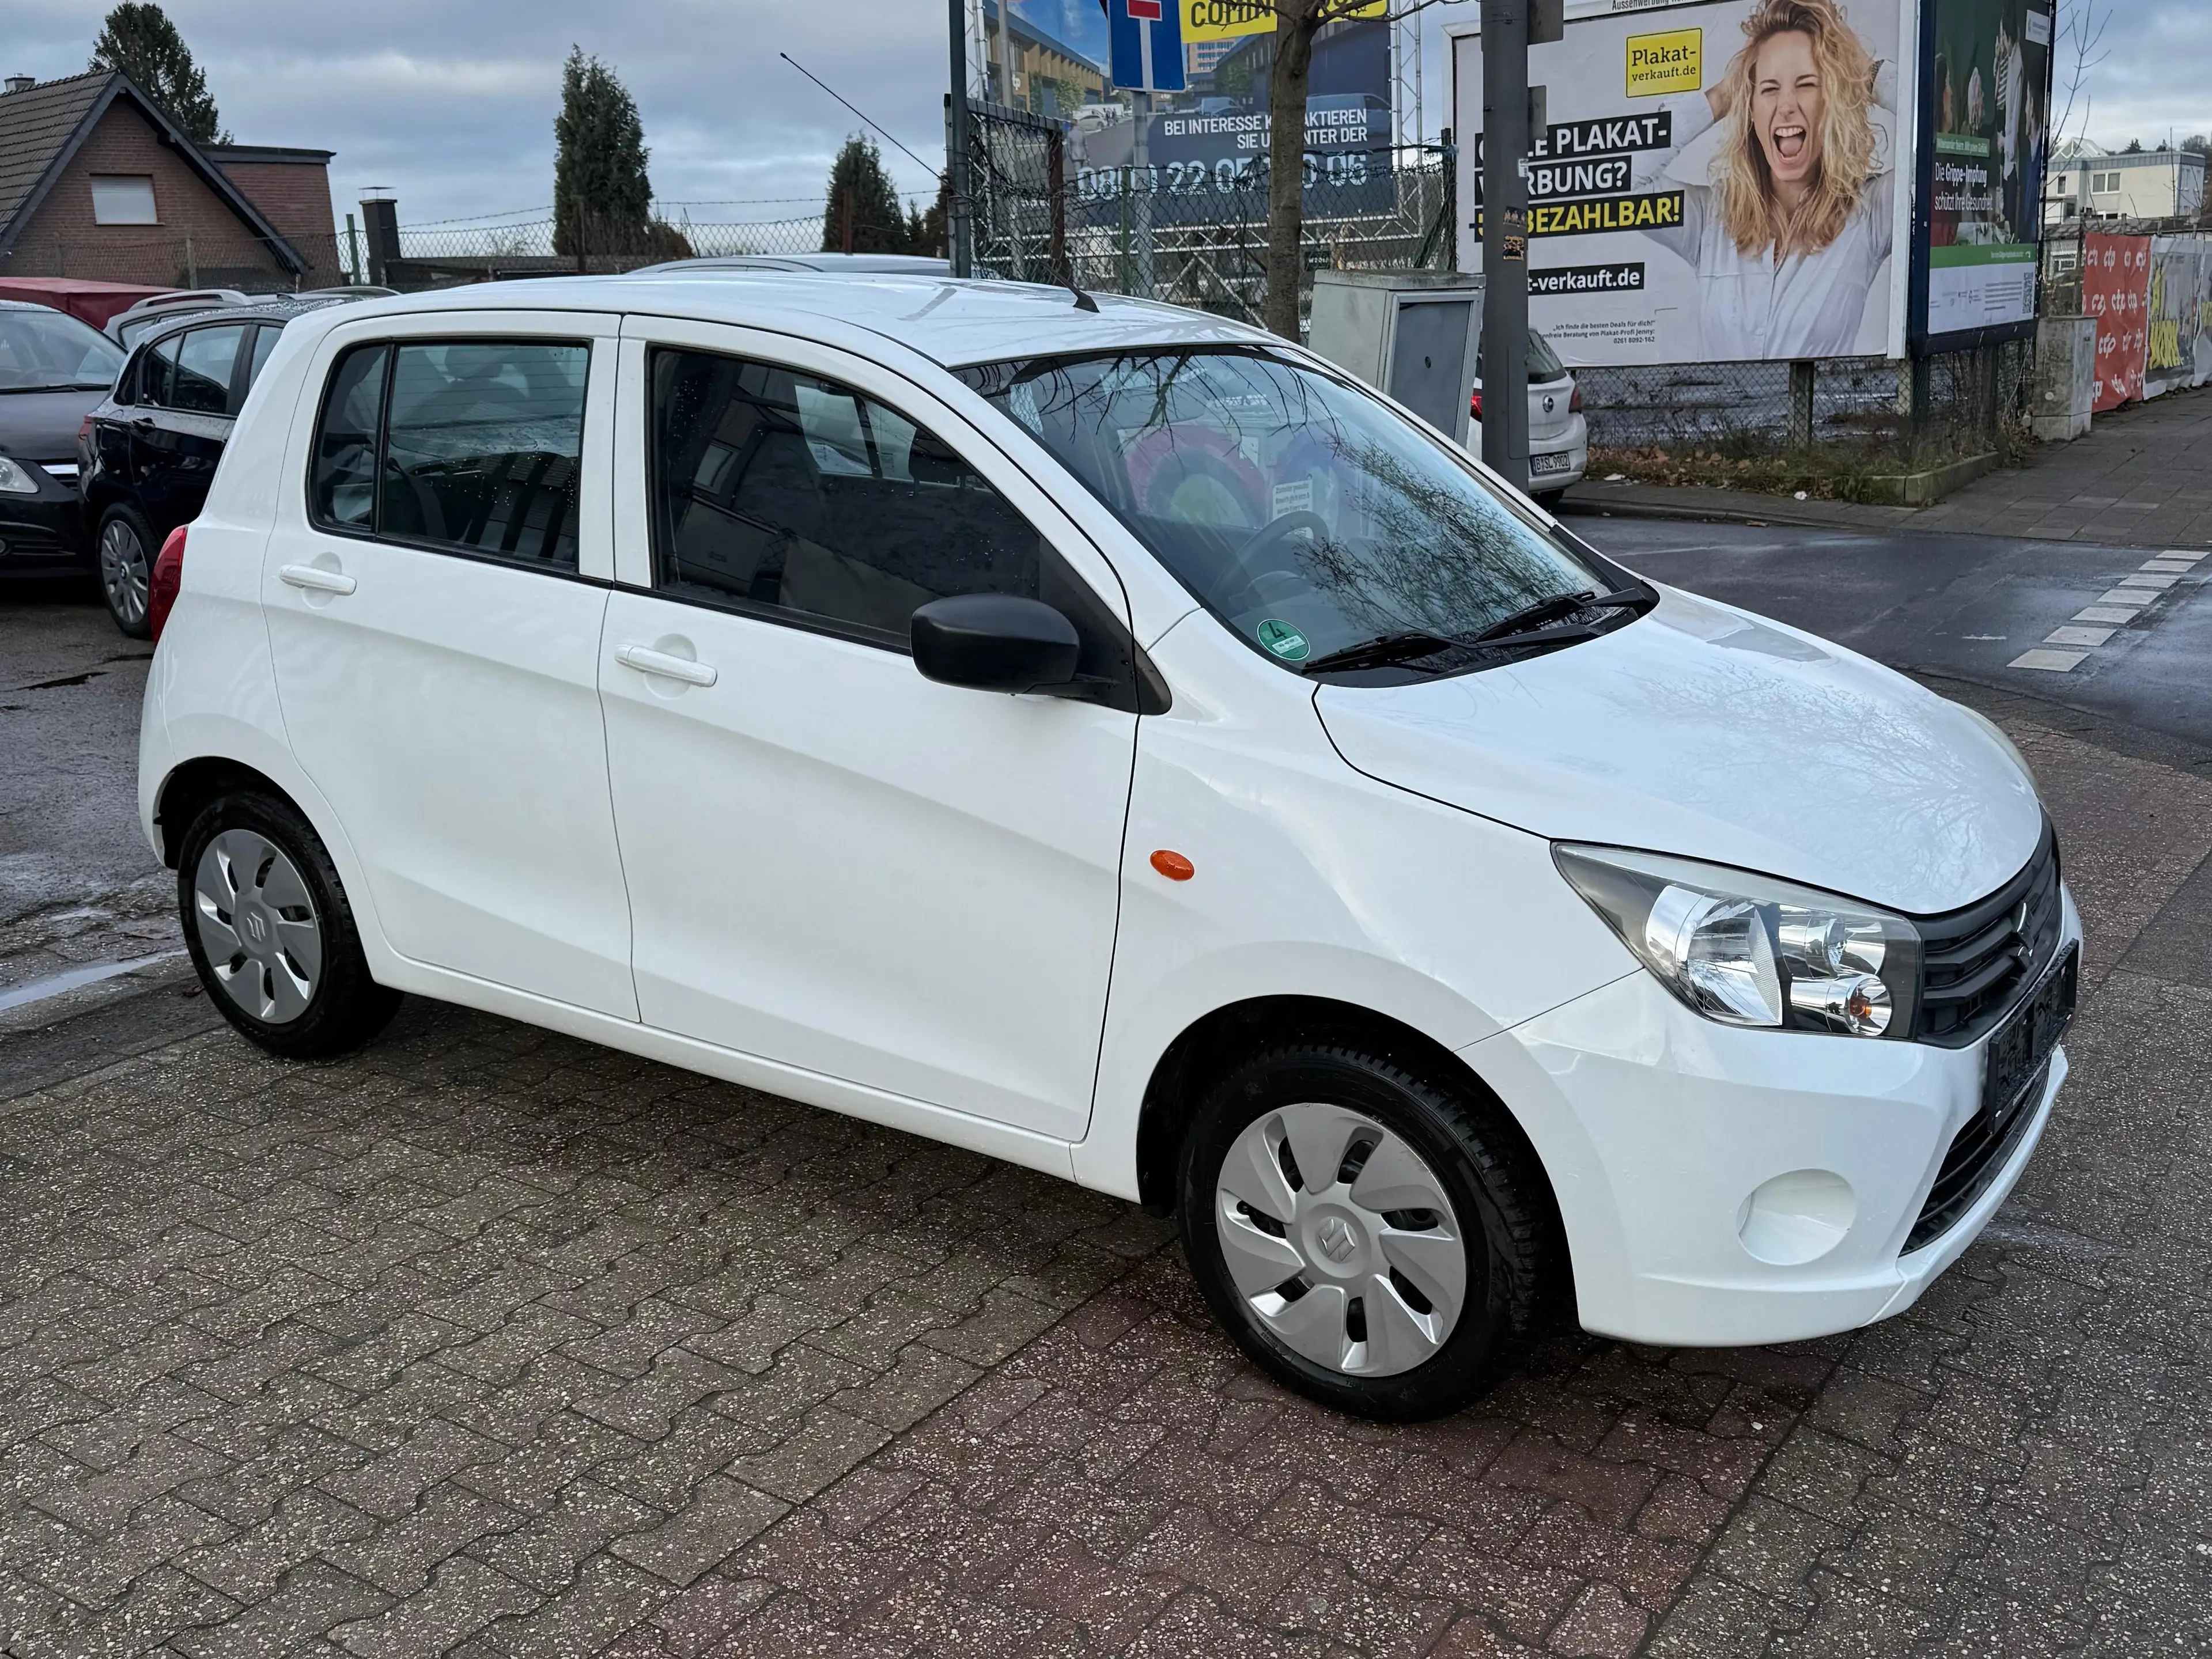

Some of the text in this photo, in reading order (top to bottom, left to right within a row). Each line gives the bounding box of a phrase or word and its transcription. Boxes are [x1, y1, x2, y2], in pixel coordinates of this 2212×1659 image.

[1191, 0, 1277, 28] COMIN
[1632, 46, 1696, 67] Plakat-
[1632, 65, 1696, 82] verkauft.de
[1164, 108, 1367, 136] BEI INTERESSE KKTIEREN
[1556, 118, 1667, 154] PLAKAT-
[1237, 134, 1258, 149] SIE
[1303, 129, 1337, 145] NTER
[1340, 126, 1367, 142] DER
[1479, 161, 1628, 196] RBUNG?
[1935, 162, 1945, 181] Die
[1478, 196, 1680, 234] BEZAHLBAR!
